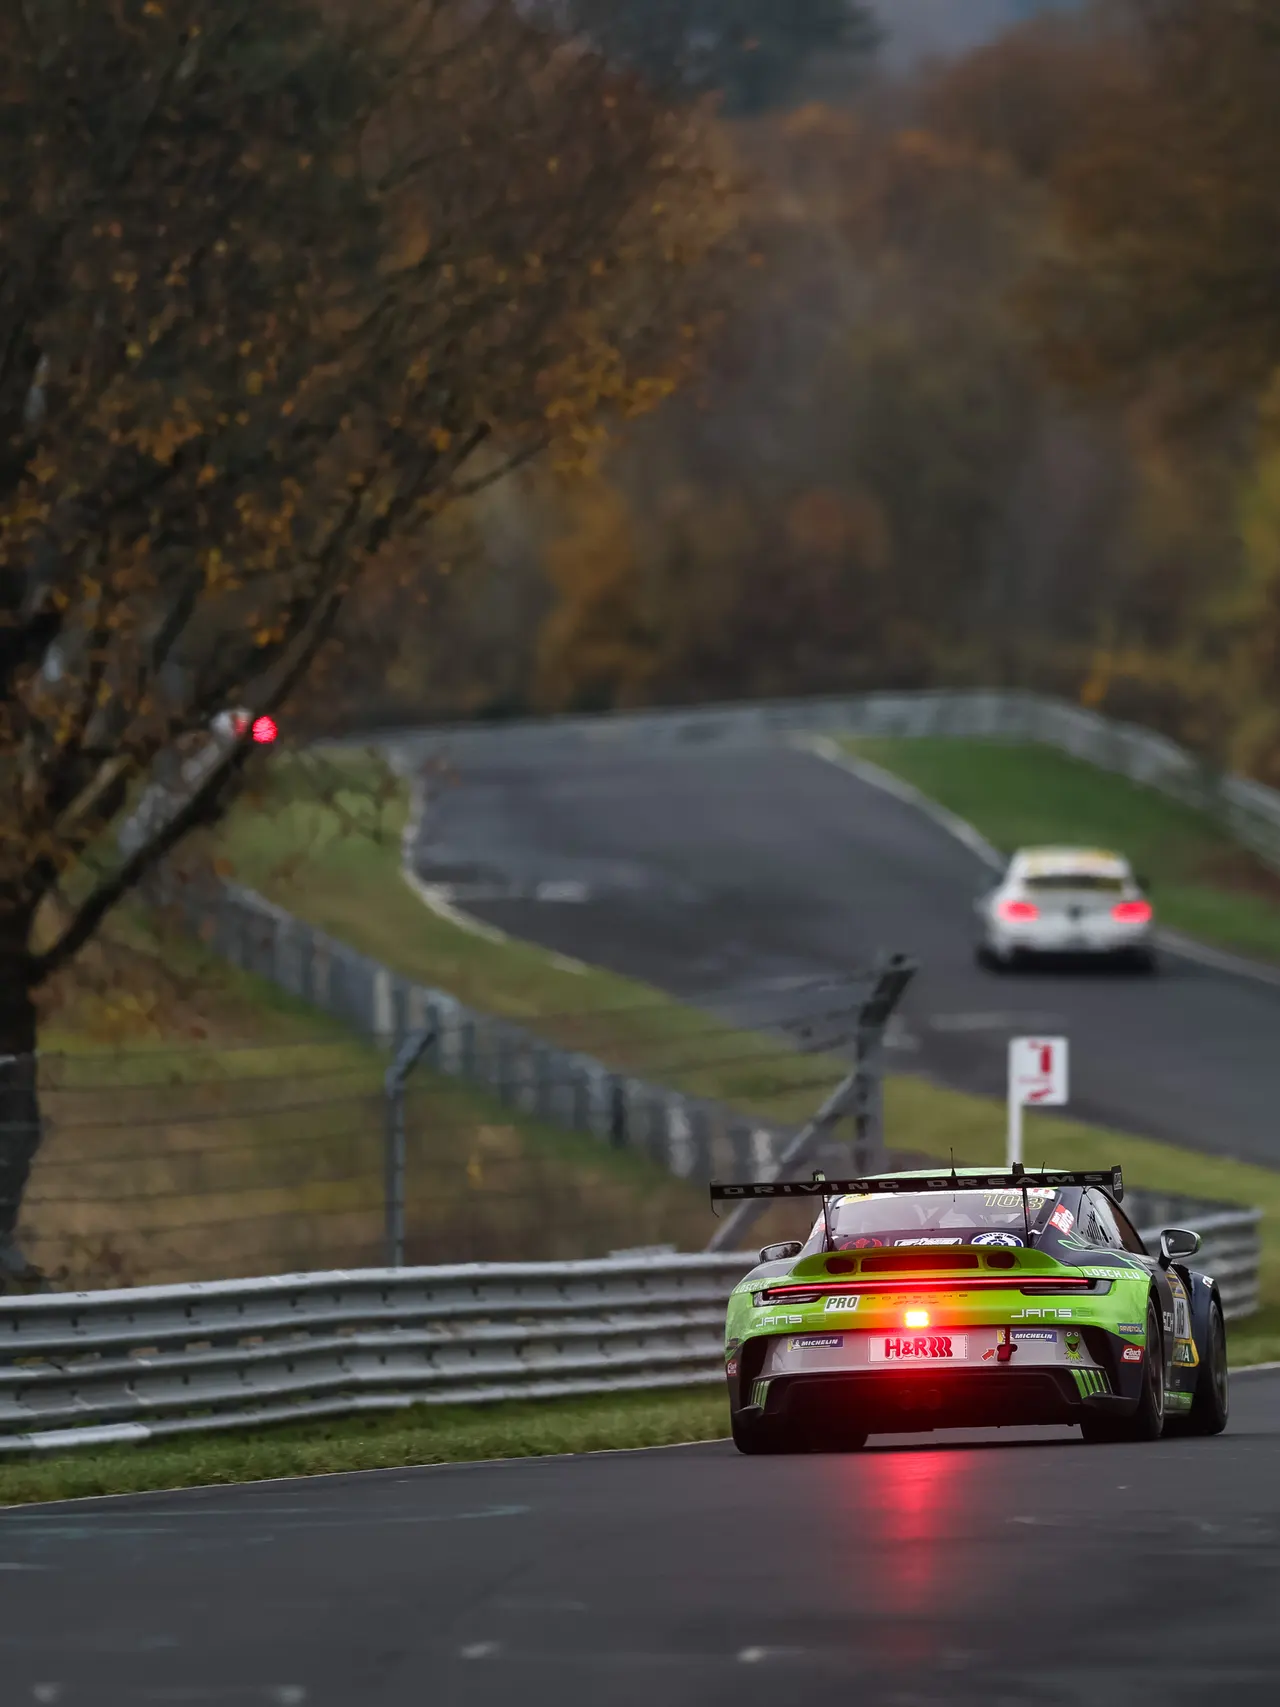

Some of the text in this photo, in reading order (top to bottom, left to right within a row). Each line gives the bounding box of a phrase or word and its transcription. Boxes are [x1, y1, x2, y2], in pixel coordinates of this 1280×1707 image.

[723, 1181, 899, 1195] DRIVING
[926, 1174, 1103, 1188] DREAMS
[983, 1193, 1045, 1211] 103
[1057, 1207, 1075, 1234] auto
[1083, 1267, 1141, 1279] LOSCH.LU
[825, 1296, 858, 1310] PRO
[1014, 1332, 1053, 1340] MICHELIN
